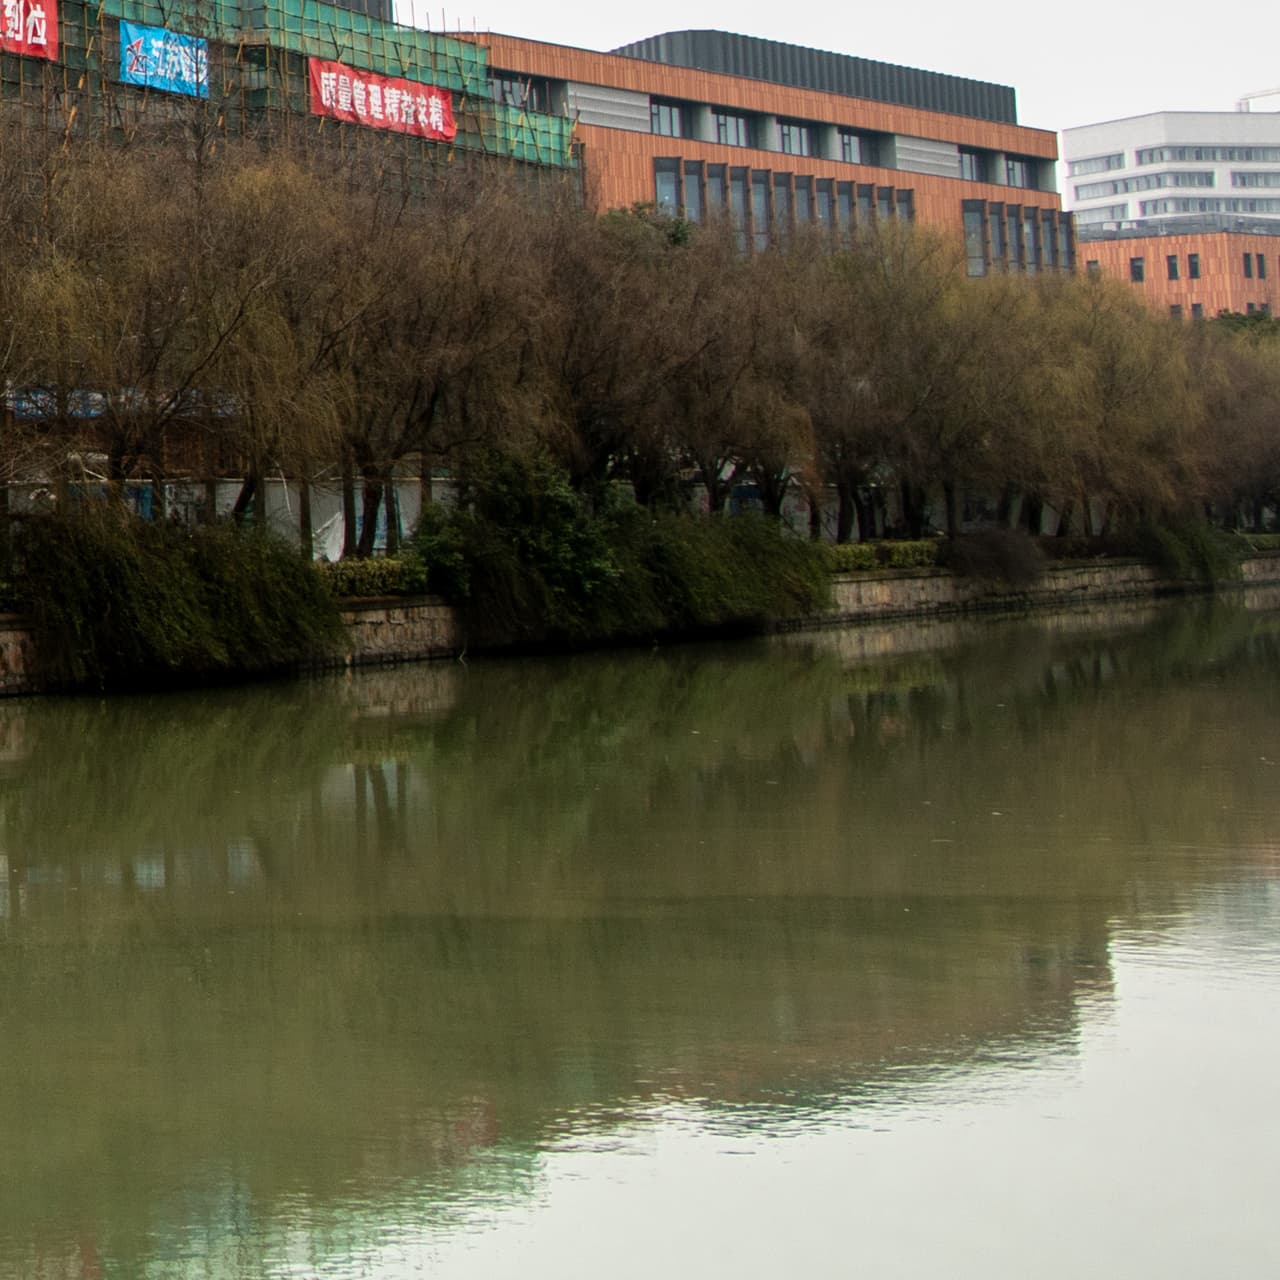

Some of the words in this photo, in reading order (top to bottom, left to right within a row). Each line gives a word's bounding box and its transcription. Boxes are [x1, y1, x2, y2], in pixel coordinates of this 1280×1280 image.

[320, 70, 445, 133] 质量管理精益求精
